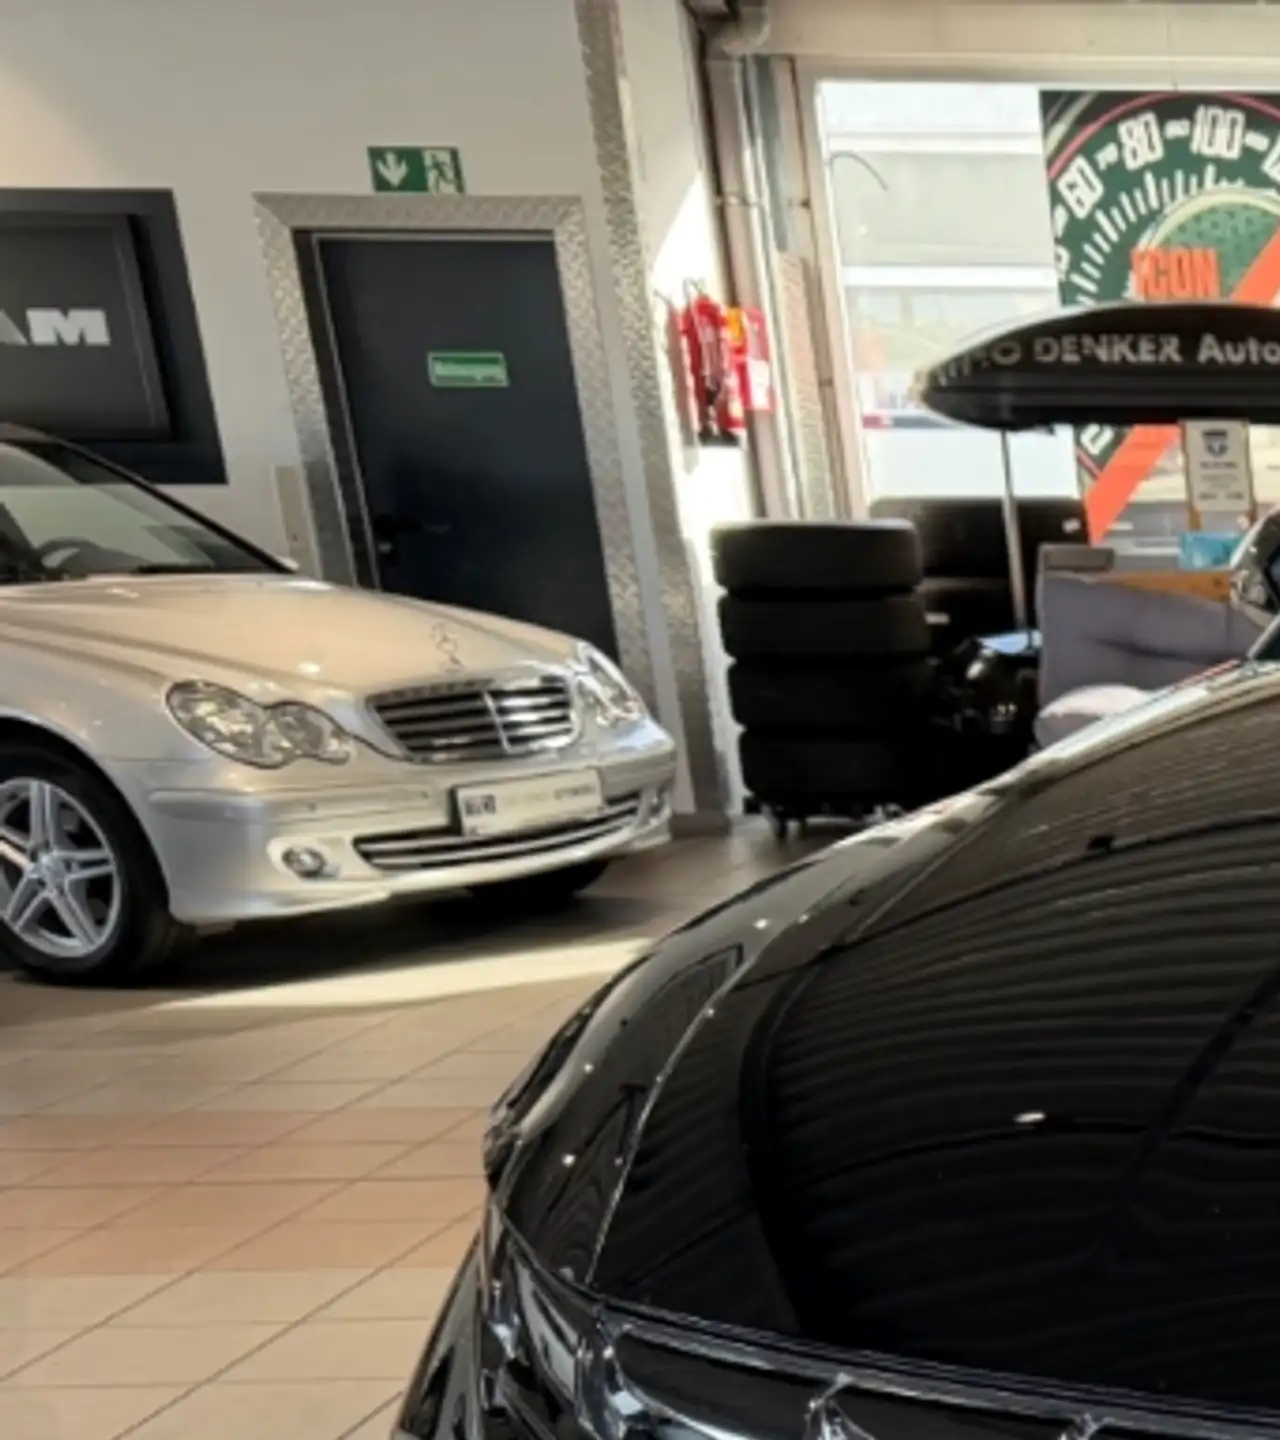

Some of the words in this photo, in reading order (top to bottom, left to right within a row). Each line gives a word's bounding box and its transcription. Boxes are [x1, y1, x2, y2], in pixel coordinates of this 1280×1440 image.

[1117, 111, 1164, 171] 80
[1190, 104, 1245, 159] 100
[1033, 334, 1181, 364] DENKER
